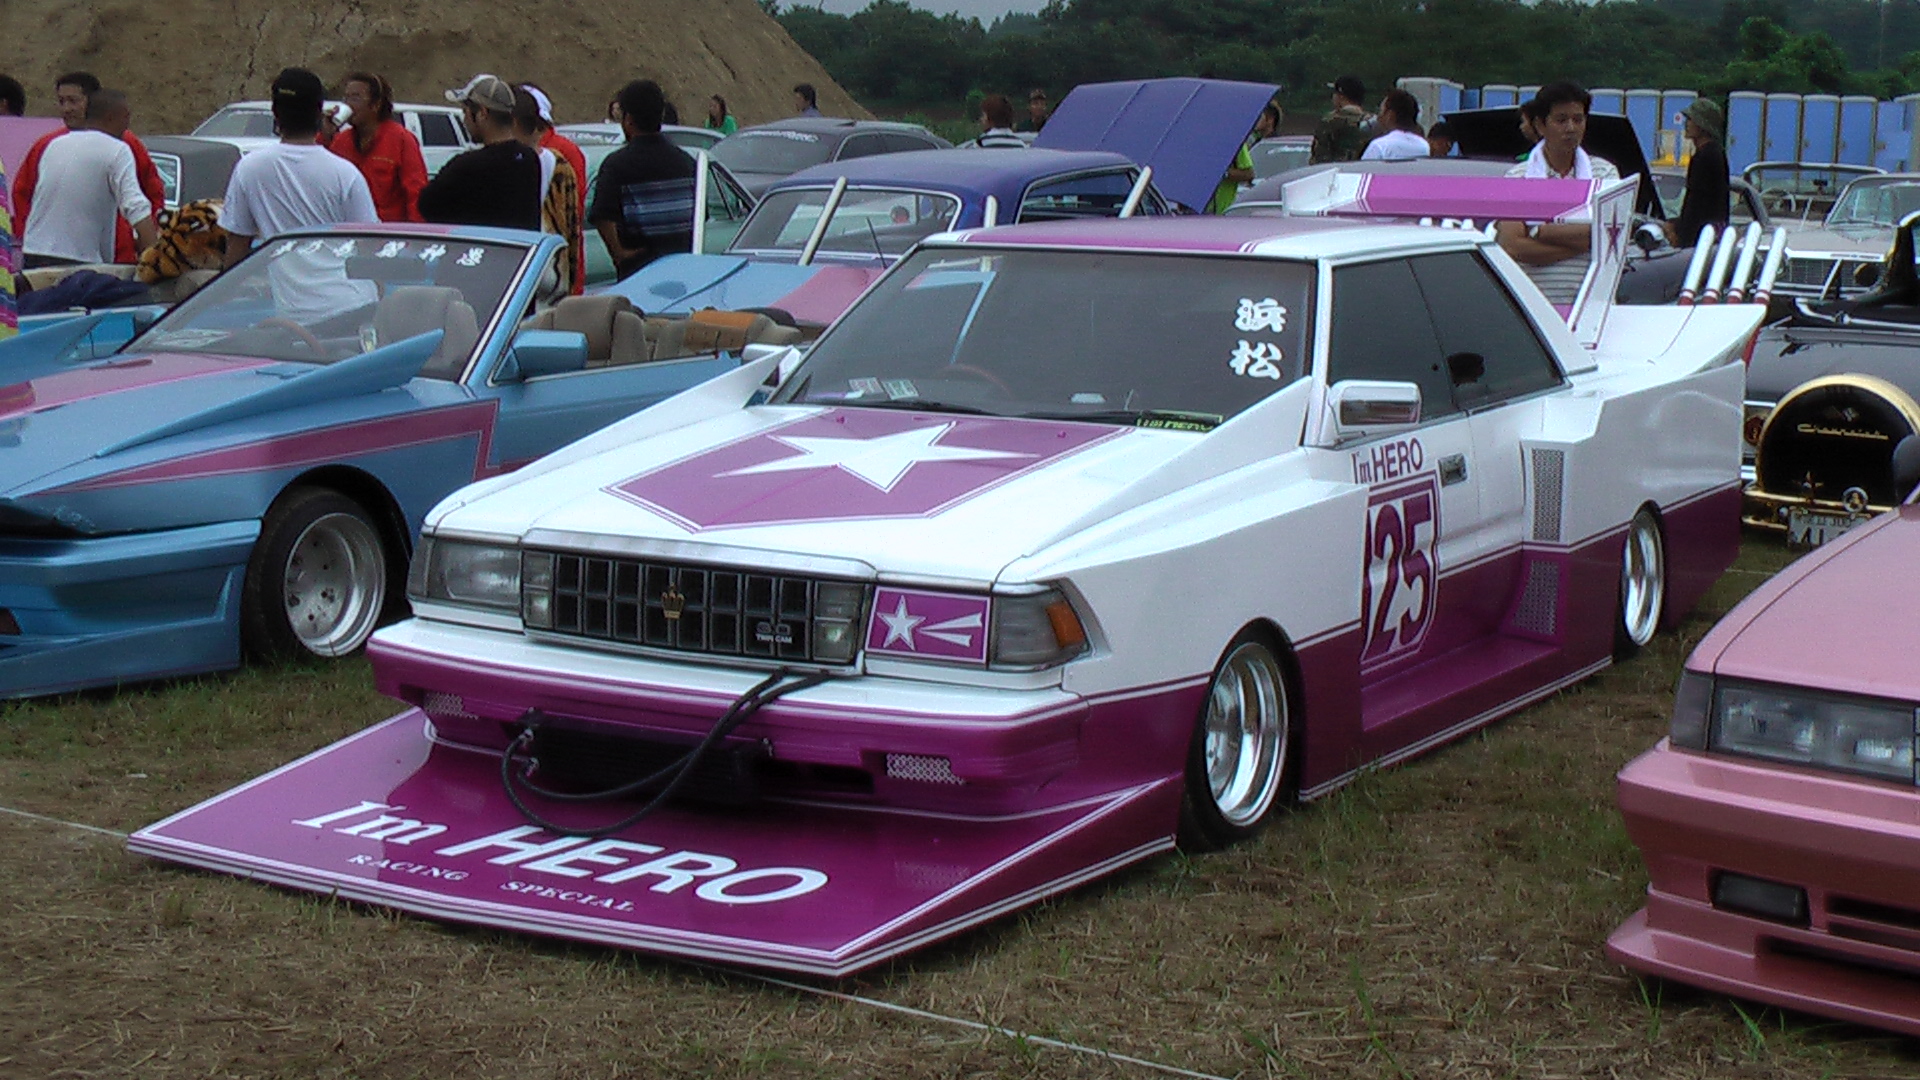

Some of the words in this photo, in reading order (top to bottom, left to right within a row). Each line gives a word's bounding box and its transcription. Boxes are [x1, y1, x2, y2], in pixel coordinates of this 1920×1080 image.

[1229, 298, 1287, 380] 浜松
[1371, 437, 1424, 483] HERO
[291, 800, 449, 845] I'm
[433, 824, 829, 904] HERO
[348, 854, 470, 881] RACING
[500, 881, 636, 912] SPECIAL
